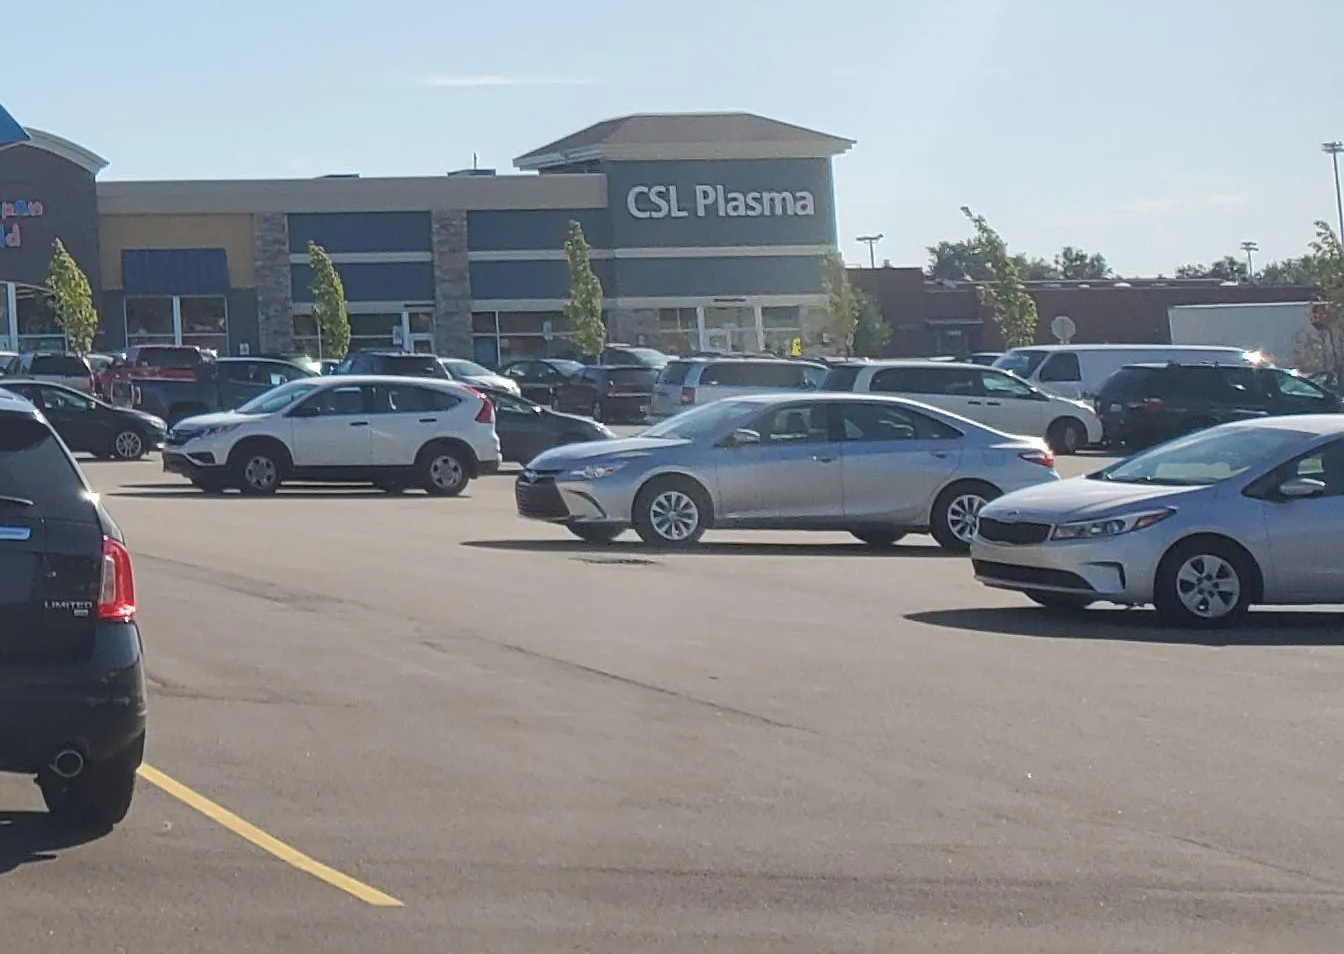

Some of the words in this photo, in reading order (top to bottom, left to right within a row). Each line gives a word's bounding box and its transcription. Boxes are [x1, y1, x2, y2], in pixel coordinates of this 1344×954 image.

[626, 185, 689, 220] CSL
[696, 183, 815, 218] Plasma
[43, 600, 93, 610] LIMITED
